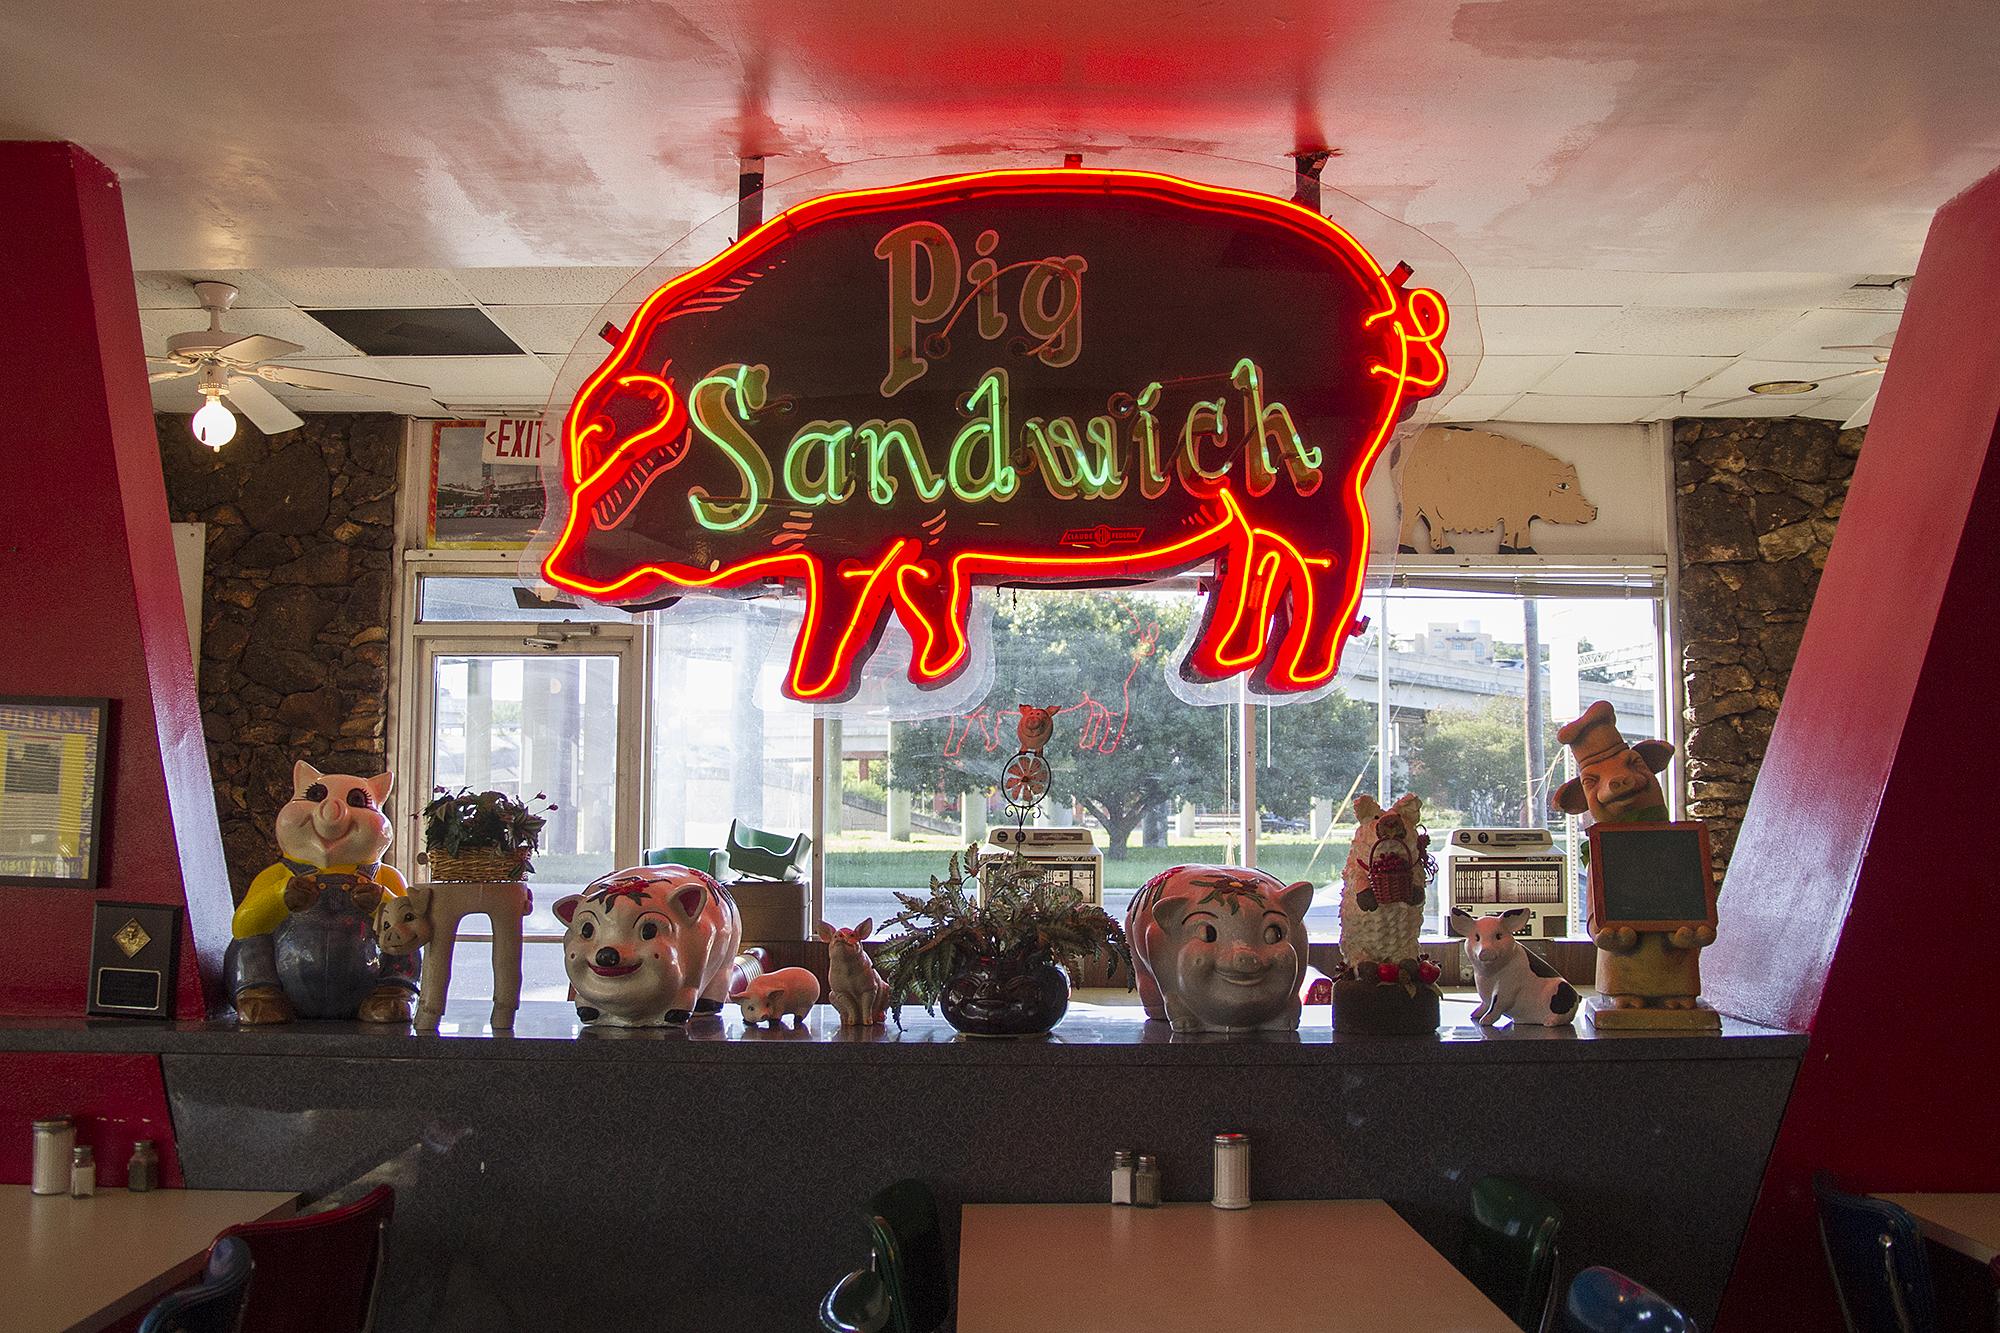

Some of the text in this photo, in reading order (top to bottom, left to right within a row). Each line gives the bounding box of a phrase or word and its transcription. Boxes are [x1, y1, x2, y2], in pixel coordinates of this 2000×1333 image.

[874, 221, 1087, 397] Pig
[496, 419, 547, 458] EXIT
[688, 357, 1323, 532] Sandwich
[1067, 531, 1138, 541] CLAUDE FEDERAL
